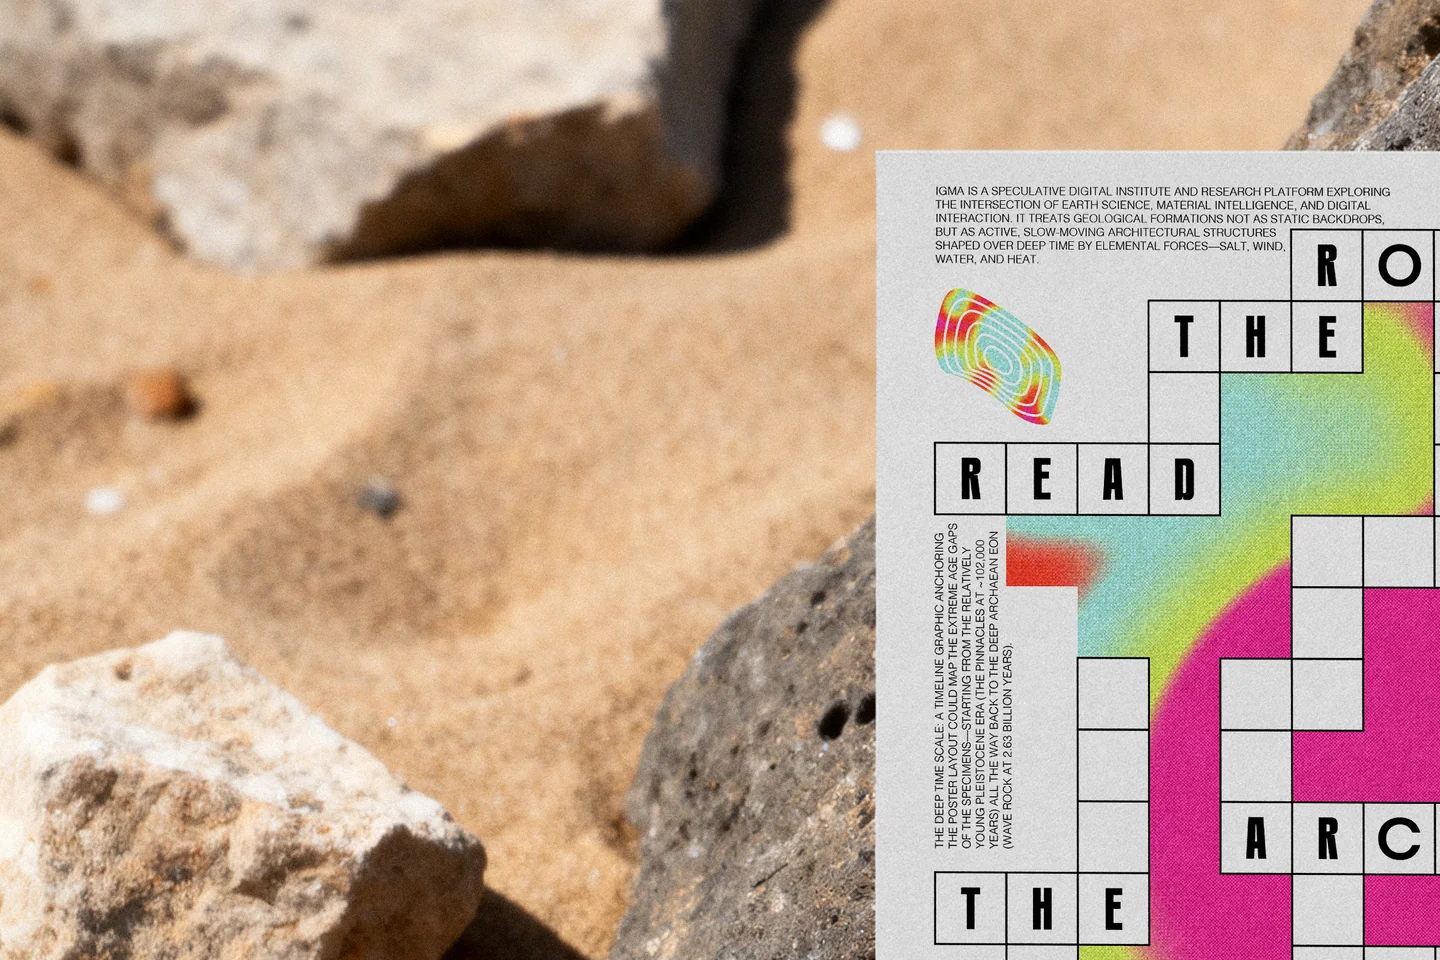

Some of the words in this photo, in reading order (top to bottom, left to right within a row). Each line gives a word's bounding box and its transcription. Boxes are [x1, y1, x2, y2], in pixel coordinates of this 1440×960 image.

[935, 199, 957, 210] THE
[960, 199, 1041, 210] INTERSECTION
[1043, 199, 1059, 210] OF
[1062, 199, 1099, 210] EARTH
[1101, 199, 1153, 211] SCIENCE,
[1156, 199, 1212, 210] MATERIAL
[1215, 200, 1297, 211] INTELLIGENCE,
[1300, 200, 1325, 211] AND
[1327, 200, 1371, 211] DIGITAL
[936, 186, 965, 196] IGMA
[968, 186, 978, 196] IS
[980, 186, 989, 196] A
[991, 186, 1066, 197] SPECULATIVE
[1069, 186, 1113, 197] DIGITAL
[1116, 186, 1171, 197] INSTITUTE
[1174, 186, 1198, 197] AND
[1201, 186, 1261, 197] RESEARCH
[1264, 186, 1324, 197] PLATFORM
[1326, 186, 1391, 198] EXPLORING
[936, 213, 1013, 224] INTERACTION.
[1016, 213, 1025, 223] IT
[1029, 213, 1071, 224] TREATS
[1073, 213, 1147, 224] GEOLOGICAL
[1150, 213, 1224, 224] FORMATIONS
[1226, 213, 1250, 224] NOT
[1253, 213, 1268, 224] AS
[1270, 213, 1309, 224] STATIC
[1312, 213, 1385, 226] BACKDROPS,
[935, 240, 981, 251] SHAPED
[983, 240, 1014, 251] OVER
[1016, 240, 1046, 251] DEEP
[1048, 240, 1075, 251] TIME
[1078, 240, 1093, 251] BY
[1095, 240, 1161, 251] ELEMENTAL
[1163, 240, 1250, 252] FORCES—SALT,
[1252, 241, 1286, 252] WIND,
[935, 253, 977, 265] WATER,
[980, 253, 1005, 264] AND
[1007, 254, 1039, 265] HEAT.
[1175, 316, 1336, 357] THE
[962, 458, 1194, 500] READ
[947, 522, 958, 554] GAPS
[988, 531, 999, 555] EON
[934, 532, 944, 602] ANCHORING
[947, 557, 958, 581] AGE
[975, 539, 986, 588] ~102,000
[975, 591, 985, 606] AT
[988, 558, 999, 621] ARCHAEAN
[948, 583, 958, 635] EXTREME
[934, 604, 944, 656] GRAPHIC
[975, 608, 985, 671] PINNACLES
[988, 623, 999, 652] DEEP
[948, 638, 958, 660] THE
[948, 662, 958, 686] MAP
[989, 656, 999, 678] THE
[1002, 643, 1013, 686] YEARS).
[934, 659, 944, 709] TIMELINE
[975, 674, 986, 701] (THE
[988, 680, 999, 696] TO
[934, 712, 944, 721] A
[947, 689, 958, 730] COULD
[975, 702, 985, 725] ERA
[988, 697, 999, 730] BACK
[1002, 689, 1012, 732] BILLION
[934, 723, 945, 763] SCALE:
[947, 732, 958, 777] LAYOUT
[989, 732, 999, 758] WAY
[1002, 735, 1012, 758] 2.63
[934, 765, 944, 792] TIME
[975, 728, 985, 805] PLEISTOCENE
[989, 760, 999, 783] THE
[1002, 761, 1012, 775] AT
[934, 794, 944, 824] DEEP
[947, 780, 958, 824] POSTER
[989, 785, 999, 806] ALL
[1002, 778, 1013, 813] ROCK
[934, 827, 944, 849] THE
[948, 827, 958, 849] THE
[975, 807, 986, 849] YOUNG
[988, 809, 1000, 849] YEARS)
[1002, 814, 1013, 849] (WAVE
[961, 887, 1122, 930] THE
